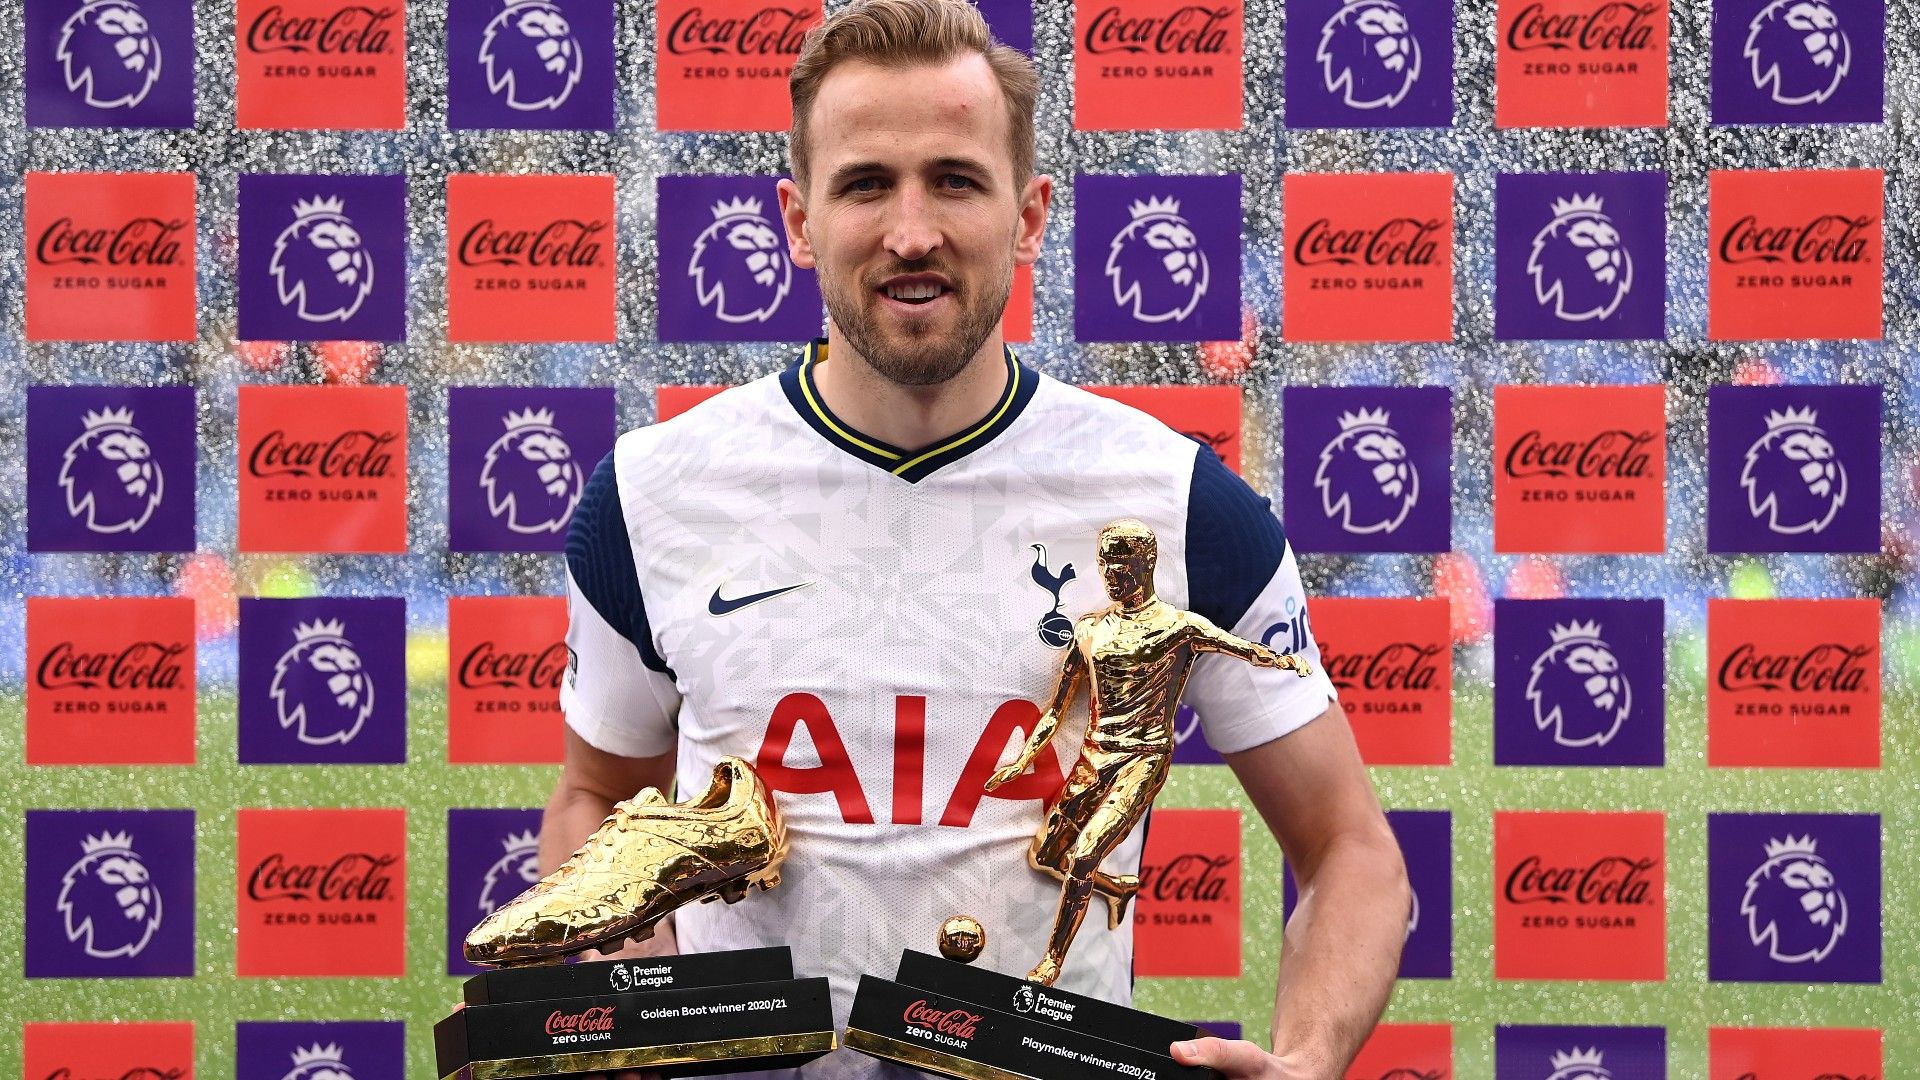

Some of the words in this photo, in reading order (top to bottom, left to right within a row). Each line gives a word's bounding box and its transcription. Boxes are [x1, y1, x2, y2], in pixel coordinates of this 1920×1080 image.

[246, 6, 398, 55] Coca-Cola
[1084, 6, 1235, 55] Coca-Cola
[1506, 2, 1660, 52] Coca-Cola
[264, 66, 309, 77] ZERO
[317, 66, 376, 77] SUGAR
[684, 67, 728, 78] ZERO
[1102, 66, 1146, 78] ZERO
[1154, 66, 1213, 78] SUGAR
[1523, 62, 1569, 75] ZERO
[1578, 62, 1638, 75] SUGAR
[36, 218, 188, 266] Coca-Cola
[457, 220, 607, 268] Coca-Cola
[1294, 218, 1446, 267] Coca-Cola
[1719, 215, 1875, 264] Coca-Cola
[53, 277, 99, 289] ZERO
[107, 277, 166, 289] SUGAR
[474, 279, 519, 290] ZERO
[528, 279, 586, 290] SUGAR
[1311, 278, 1356, 289] ZERO
[1364, 278, 1423, 289] SUGAR
[1737, 275, 1783, 287] ZERO
[1791, 275, 1852, 287] SUGAR
[248, 430, 398, 479] Coca-Cola
[1503, 430, 1657, 479] Coca-Cola
[265, 489, 311, 501] ZERO
[318, 489, 377, 501] SUGAR
[1522, 490, 1567, 502] ZERO
[1575, 490, 1635, 502] SUGAR
[36, 642, 189, 690] Coca-Cola
[1717, 643, 1873, 693] Coca-Cola
[53, 701, 100, 713] ZERO
[107, 701, 167, 713] SUGAR
[475, 701, 520, 712] ZERO
[528, 701, 561, 712] SUG
[1363, 703, 1422, 714] SUGAR
[1735, 704, 1782, 716] ZERO
[1790, 704, 1851, 716] SUGAR
[757, 692, 1066, 827] AIA
[247, 853, 399, 902] Coca-Cola
[1504, 856, 1658, 906] Coca-Cola
[264, 913, 310, 925] ZERO
[317, 913, 377, 925] SUGAR
[1153, 913, 1212, 925] SUGAR
[1522, 915, 1568, 928] ZERO
[1575, 915, 1636, 928] SUGAR
[633, 965, 672, 976] Premier
[634, 975, 673, 987] League
[641, 1007, 680, 1020] Golden
[681, 1005, 708, 1016] Boot
[708, 1003, 746, 1014] winner
[747, 999, 788, 1011] 2020/21
[1034, 1002, 1073, 1022] League
[1037, 993, 1076, 1012] Premier
[545, 1006, 616, 1035] Coca-Cola
[903, 1000, 984, 1040] Coca-Cola
[552, 1034, 578, 1045] zero
[580, 1032, 612, 1042] SUGAR
[905, 1025, 933, 1040] zero
[934, 1033, 968, 1050] SUGAR
[1021, 1036, 1079, 1060] Playmaker
[1080, 1054, 1117, 1070] winner
[1117, 1063, 1156, 1080] 2020/21
